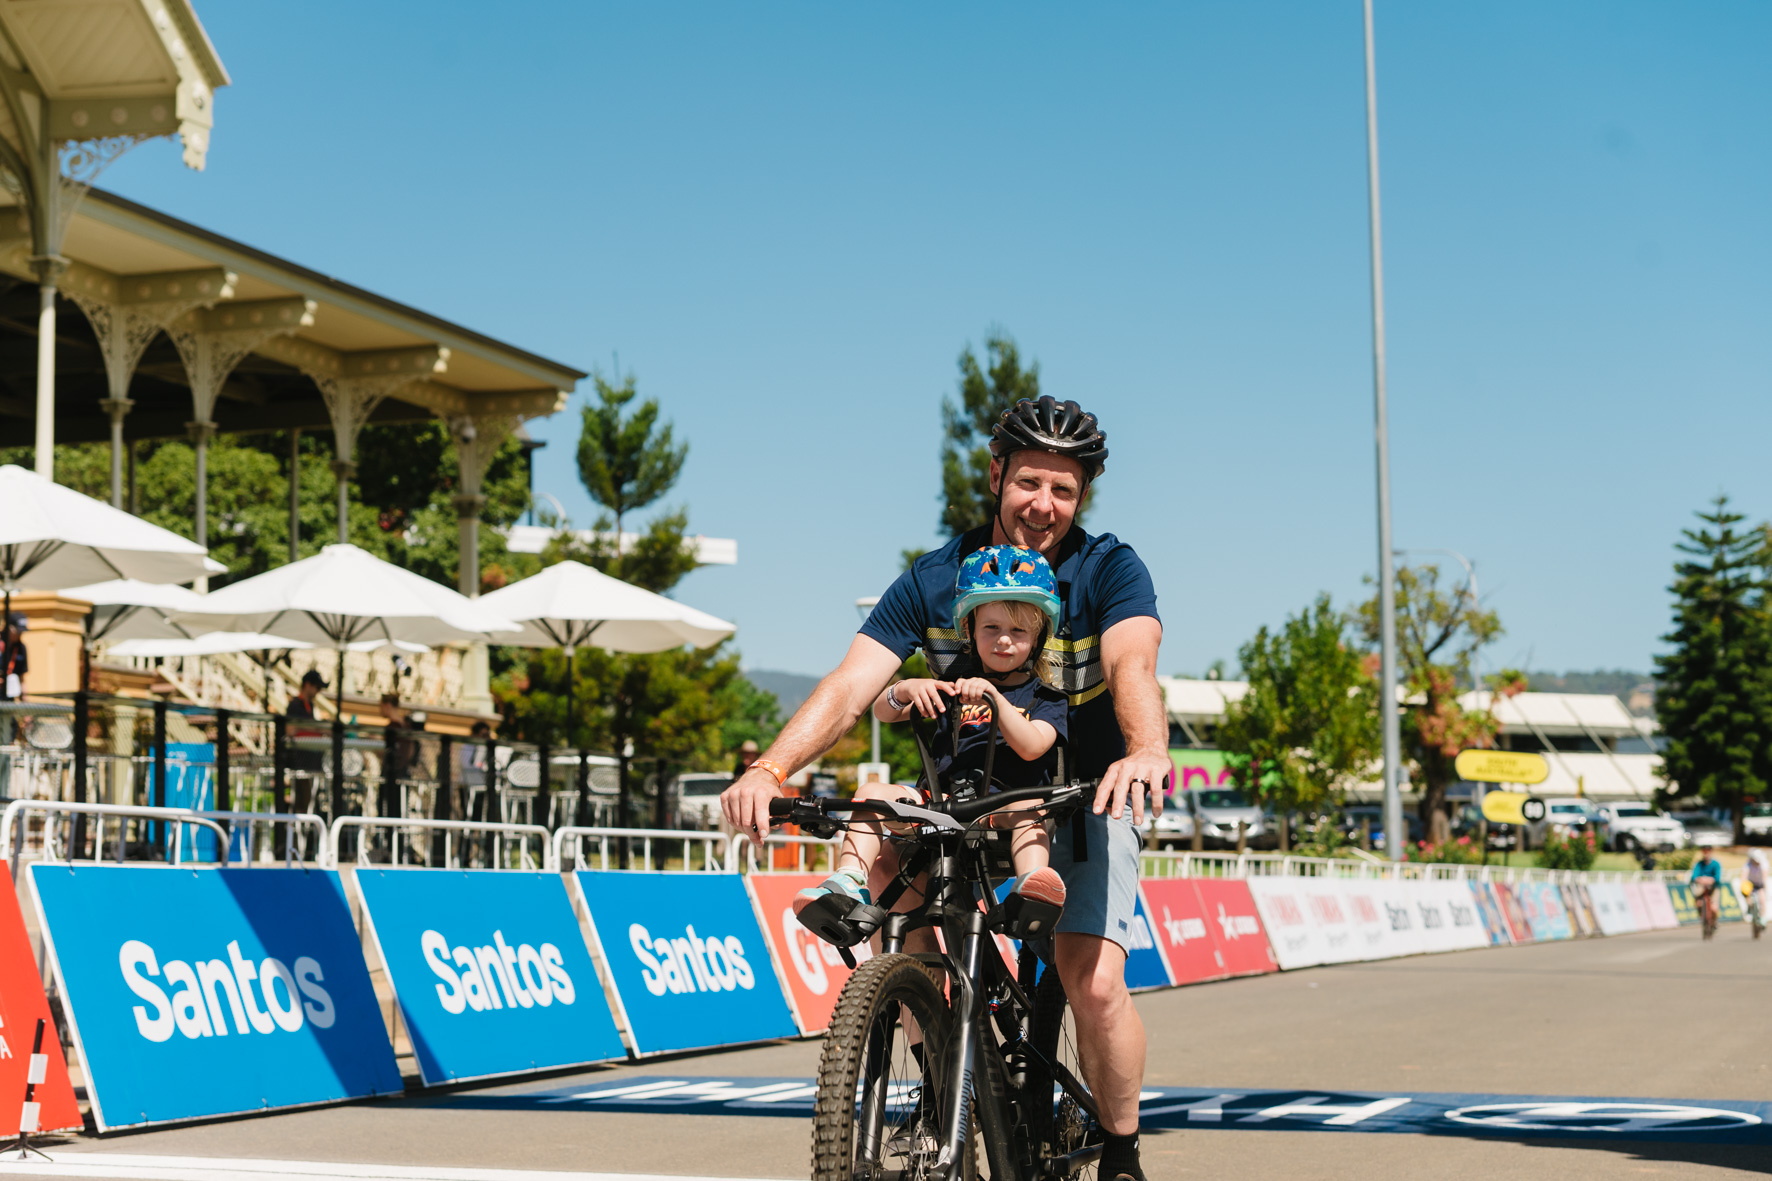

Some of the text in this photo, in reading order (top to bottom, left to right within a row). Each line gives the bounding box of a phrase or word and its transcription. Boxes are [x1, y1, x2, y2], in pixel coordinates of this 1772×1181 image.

[119, 940, 336, 1043] Santos
[421, 929, 576, 1014] Santos
[628, 923, 755, 996] Santos
